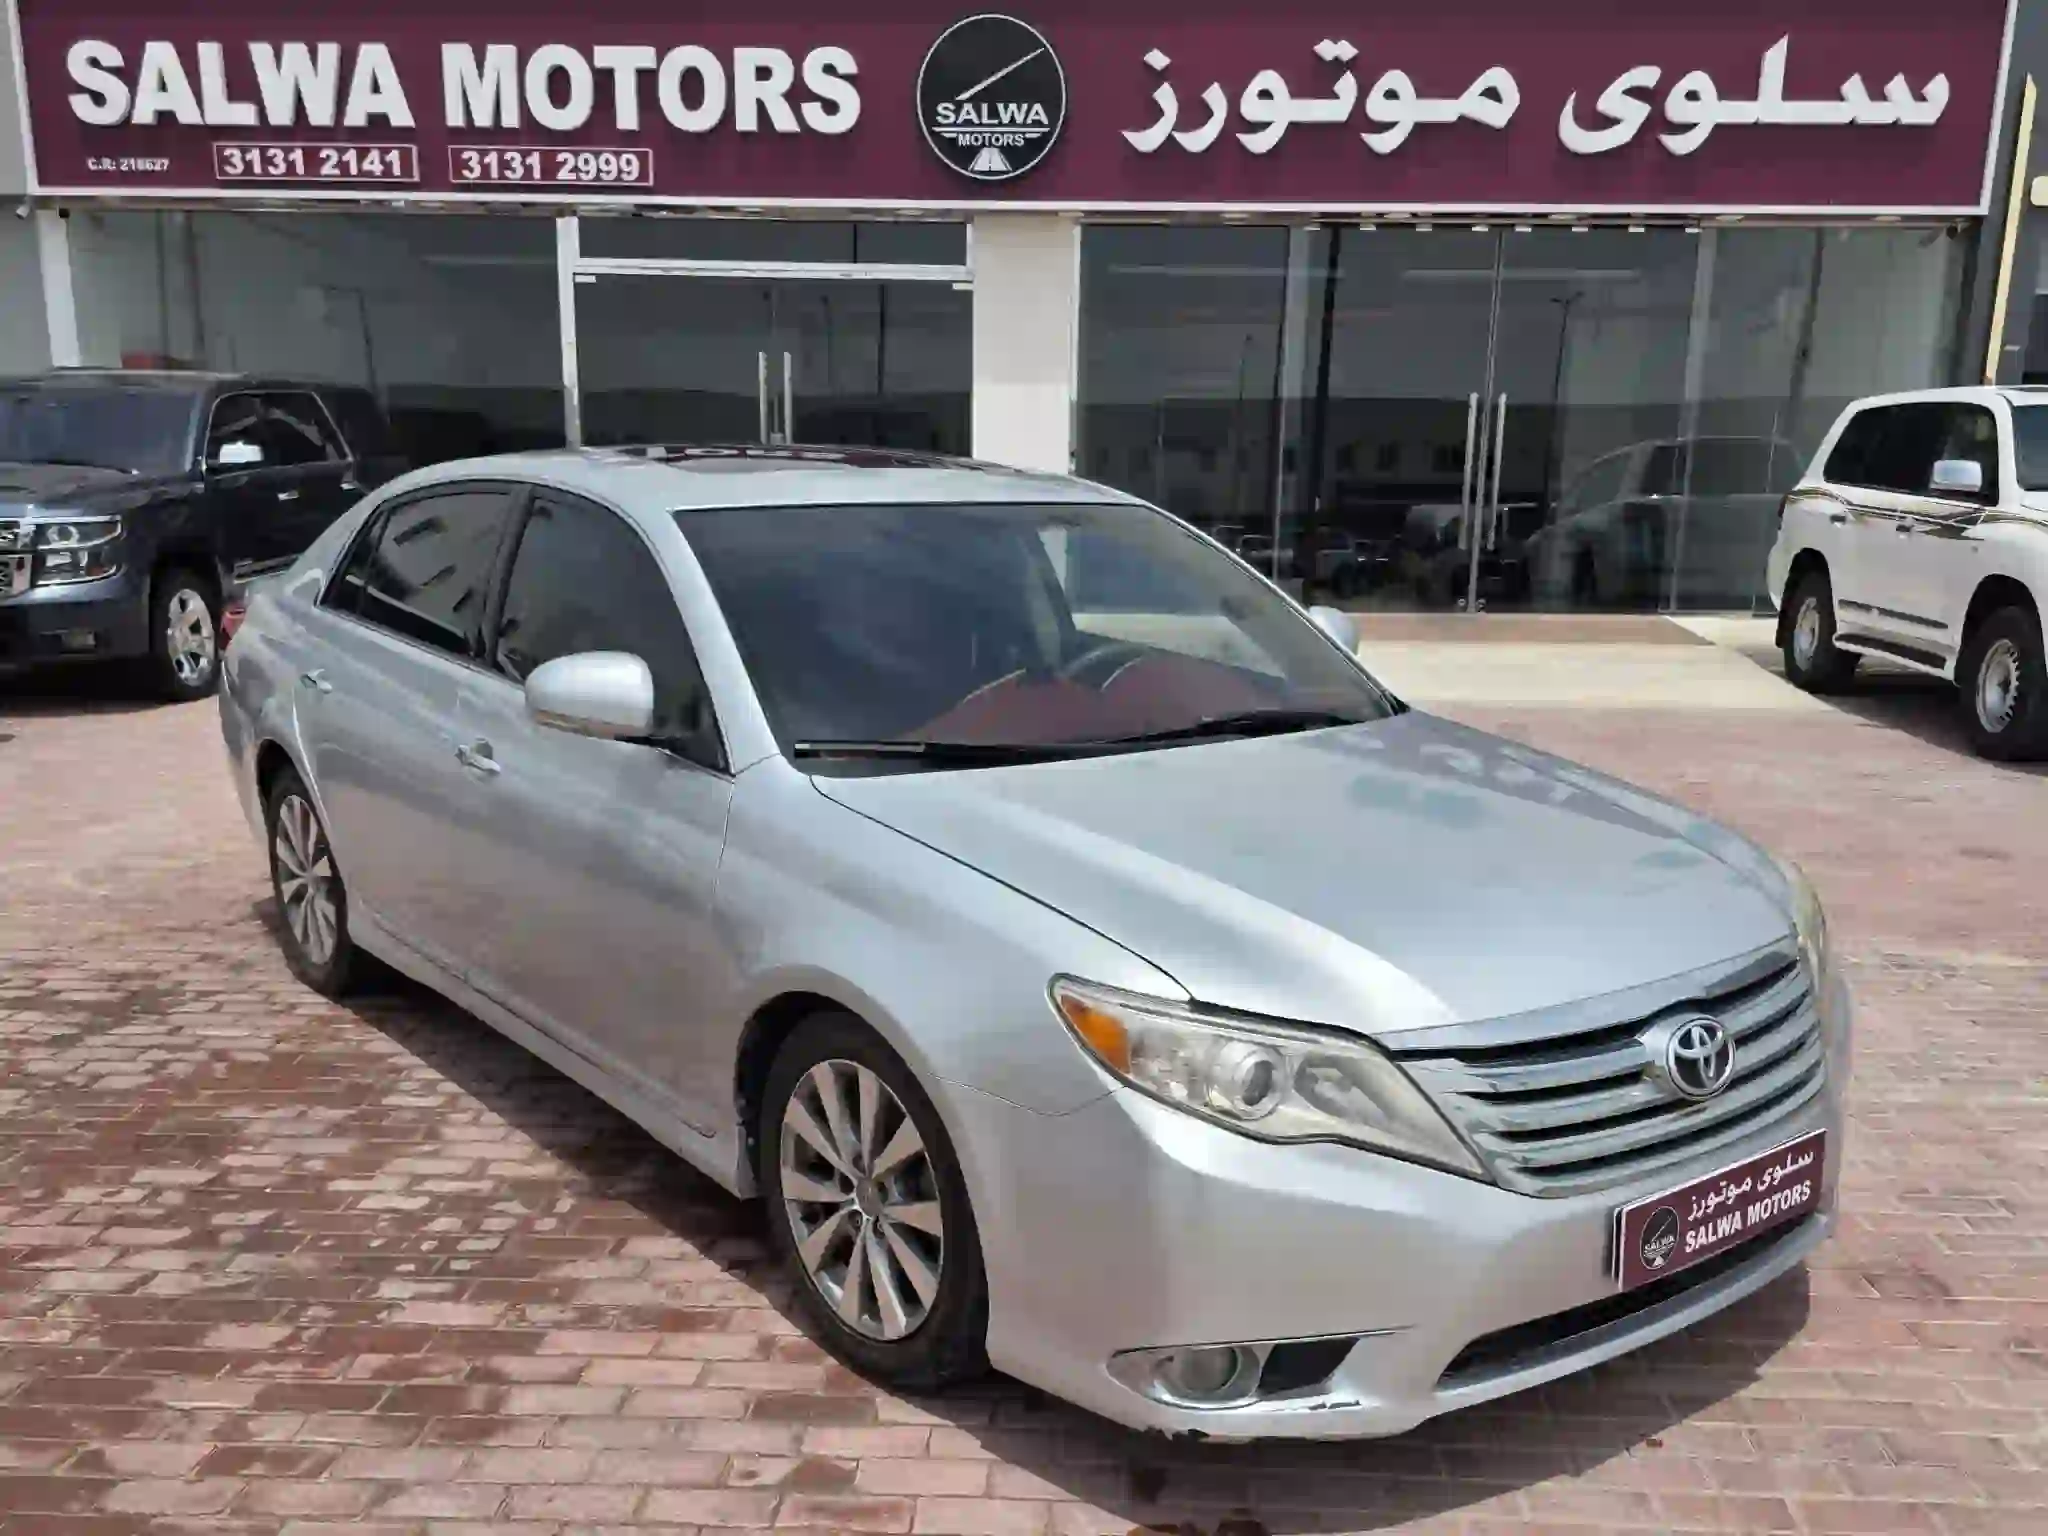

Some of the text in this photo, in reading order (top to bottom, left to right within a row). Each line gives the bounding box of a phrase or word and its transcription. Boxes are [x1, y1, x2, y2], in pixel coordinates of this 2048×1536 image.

[67, 39, 861, 134] SALWA MOTORS
[1121, 36, 1950, 155] سلوى موتورز
[935, 102, 1049, 125] SALWA
[223, 148, 402, 176] 3131 2141
[460, 150, 640, 181] 3131 2999
[957, 133, 1026, 147] MOTORS
[1687, 1150, 1814, 1221] سلوى موتورز
[1684, 1179, 1812, 1253] SALWA MOTORS
